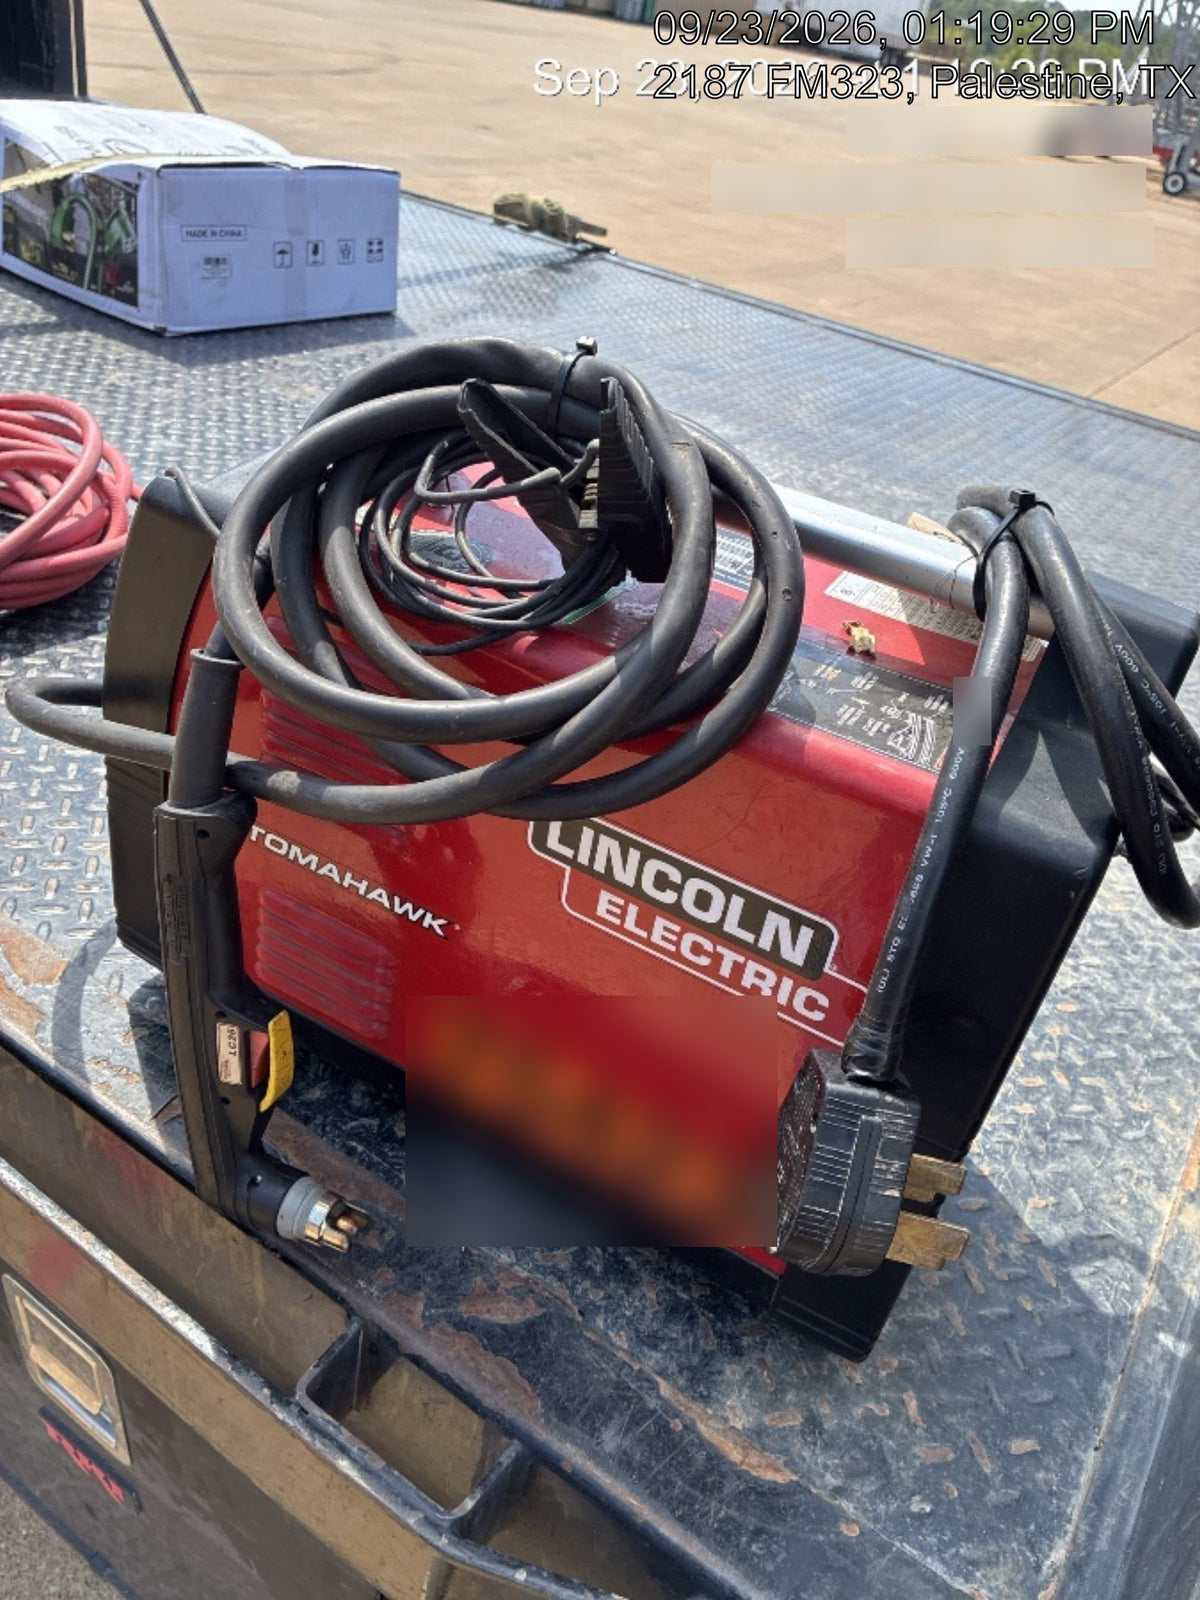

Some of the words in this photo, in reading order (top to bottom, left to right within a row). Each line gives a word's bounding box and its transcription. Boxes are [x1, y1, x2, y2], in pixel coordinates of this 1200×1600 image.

[1114, 643, 1140, 674] 600V
[921, 834, 938, 868] VW-1
[949, 747, 966, 780] 600V
[249, 824, 448, 937] TOMAHAWK
[546, 820, 815, 967] LINCOLN
[595, 888, 830, 1022] ELECTRIC
